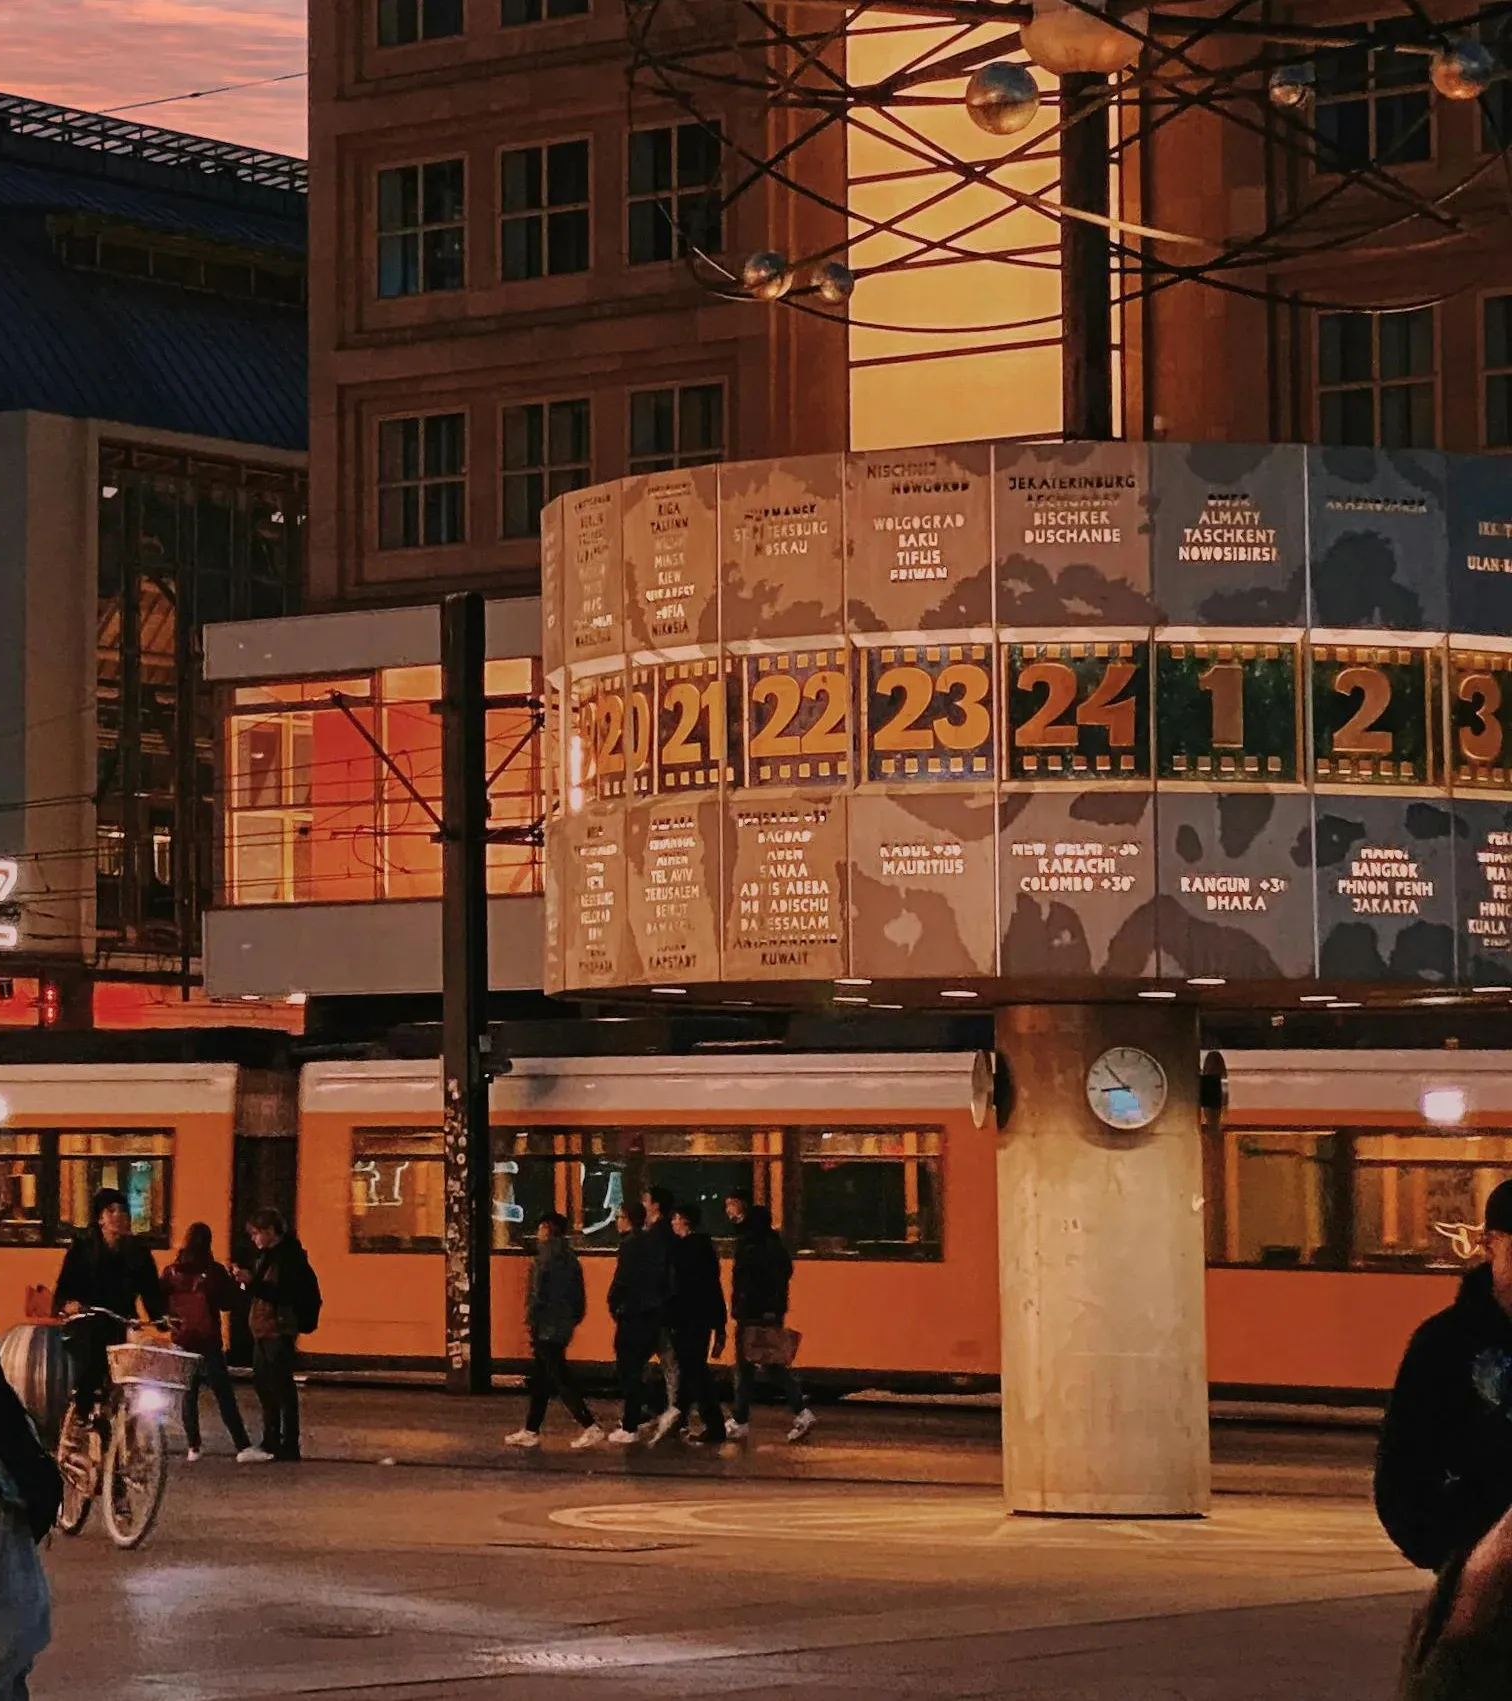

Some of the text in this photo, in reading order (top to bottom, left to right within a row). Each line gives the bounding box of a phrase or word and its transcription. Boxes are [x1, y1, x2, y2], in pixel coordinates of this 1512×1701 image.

[1009, 476, 1135, 490] JEKATERINBURG
[873, 513, 965, 531] WOLGOGRAD
[1033, 511, 1109, 525] BISCHKEK
[1198, 511, 1261, 525] ALMATY
[898, 532, 939, 548] BAKU
[1024, 529, 1121, 543] DUSCHANBE
[1184, 528, 1276, 543] TASCHKENT
[896, 550, 941, 566] TIFLIS
[874, 663, 991, 750] 23
[1015, 662, 1137, 748] 24
[1199, 664, 1244, 749] 1
[1333, 667, 1393, 752] 2
[750, 671, 847, 758] 22
[1459, 674, 1503, 761] 3
[662, 681, 724, 765] 21
[597, 692, 651, 775] 20
[1011, 842, 1046, 856] NEW
[883, 859, 965, 875] MAURITIUS
[1038, 858, 1116, 873] KARACHI
[1351, 861, 1419, 878] BANGKOK
[740, 880, 829, 897] ADIS ABEBA
[1020, 876, 1094, 891] COLOMBO
[1180, 876, 1250, 892] RANGUN
[1338, 879, 1433, 896] PHNOM PENH
[645, 885, 699, 901] JERUSALEM
[740, 898, 829, 914] MOADISCHU
[1206, 895, 1267, 911] DHAKA
[1353, 898, 1420, 914] JAKARTA
[740, 915, 829, 931] DAESSALAM
[1467, 919, 1506, 935] KUALA
[760, 952, 809, 966] KUWAIT
